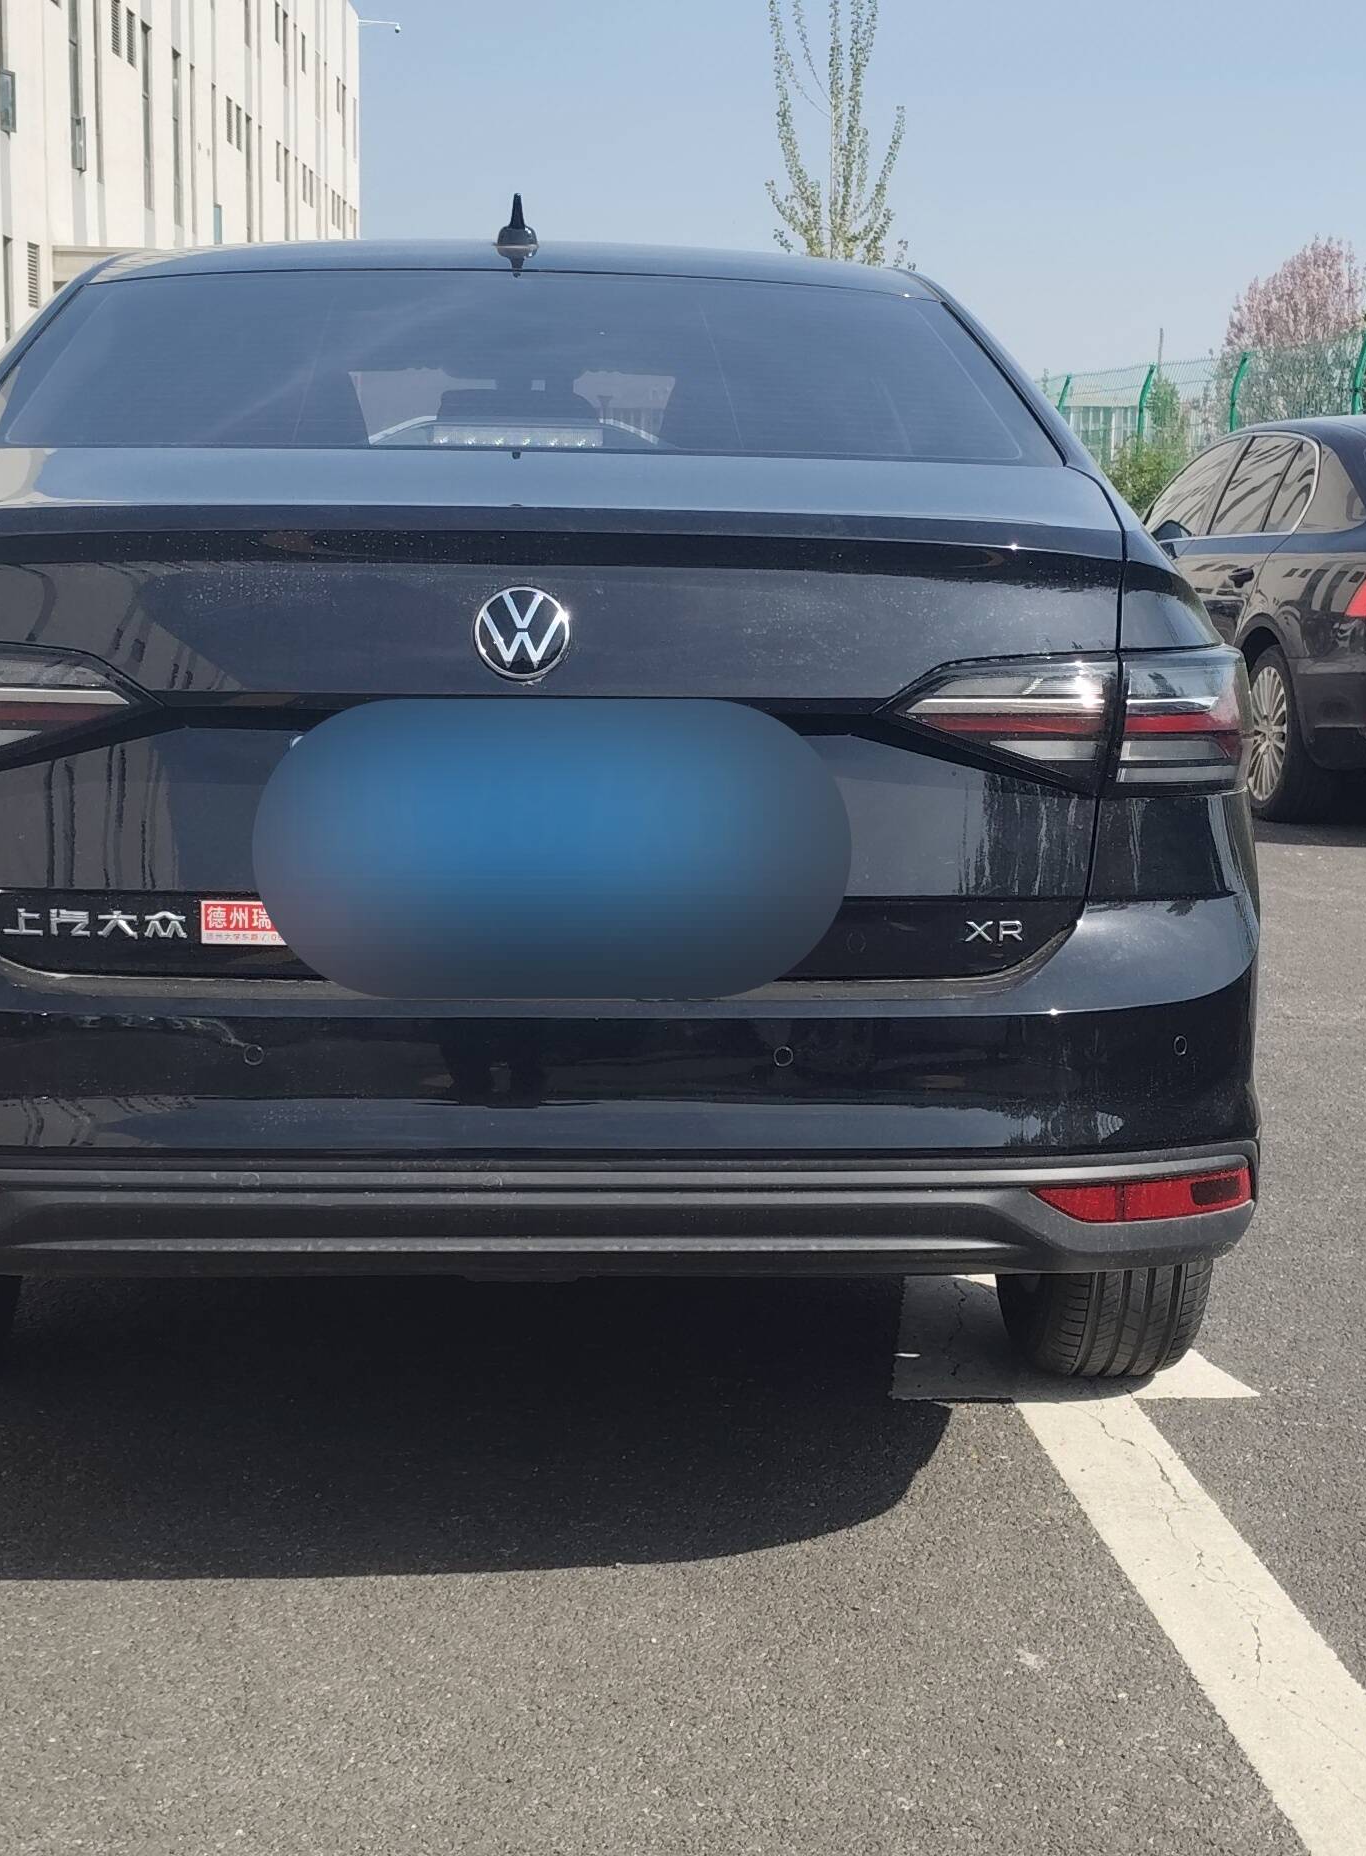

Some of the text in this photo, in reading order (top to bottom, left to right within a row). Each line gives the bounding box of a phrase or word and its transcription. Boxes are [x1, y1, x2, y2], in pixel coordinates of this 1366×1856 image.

[2, 908, 188, 939] 上汽大众
[964, 920, 1024, 942] XR
